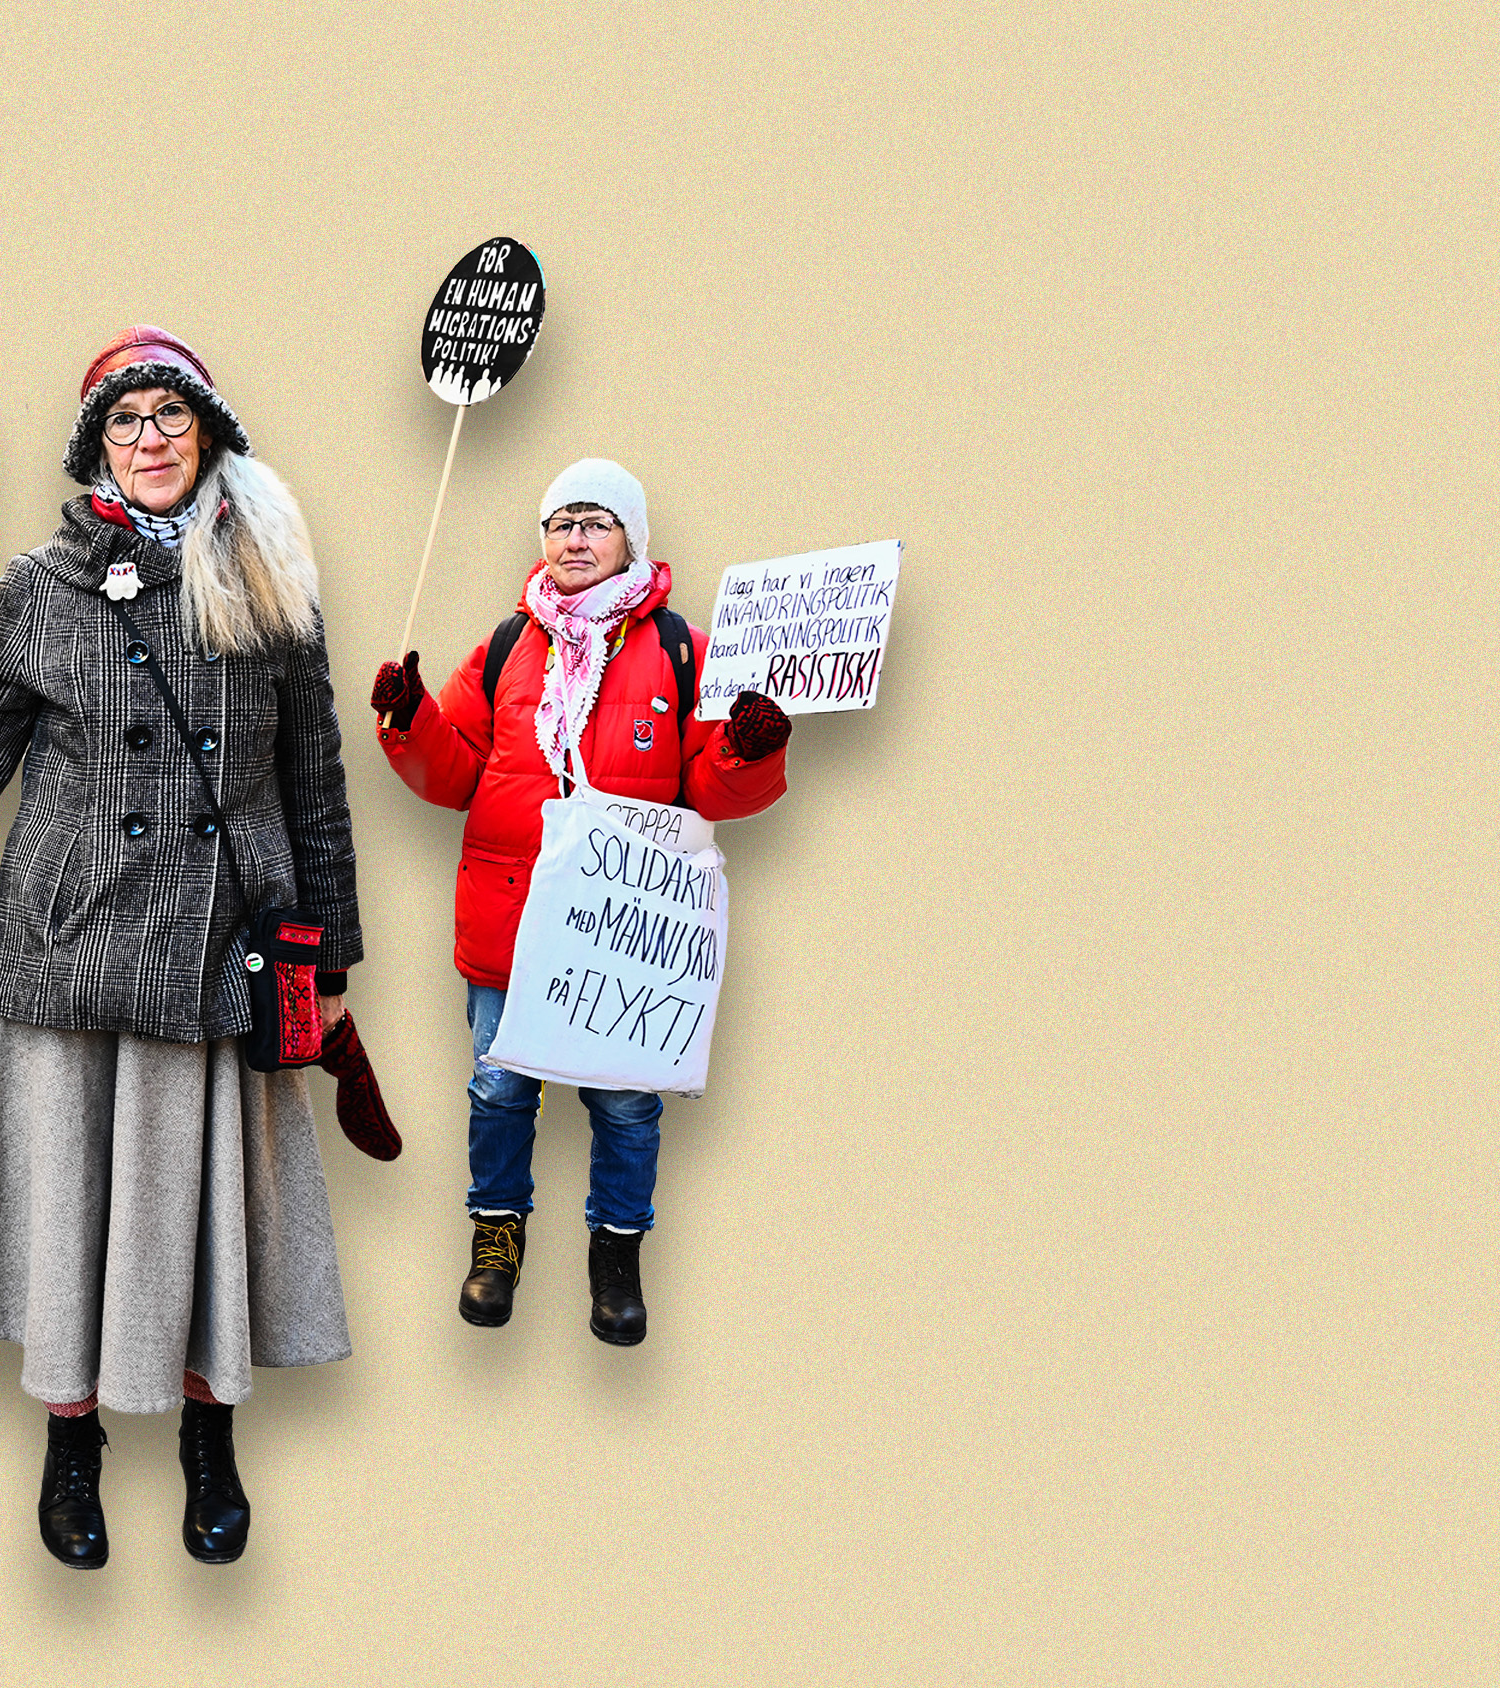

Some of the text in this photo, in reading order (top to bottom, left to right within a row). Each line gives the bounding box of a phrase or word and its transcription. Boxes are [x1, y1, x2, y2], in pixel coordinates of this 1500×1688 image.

[476, 240, 512, 273] FÖR
[444, 278, 538, 312] EN HUMAN
[431, 336, 500, 366] POLITIK!
[724, 562, 876, 600] Idag har vi ingen
[717, 579, 894, 628] INVANDRINGSPOLITIK
[710, 613, 887, 659] bara UTVISNINGSPOLITIK
[700, 677, 722, 699] och
[764, 647, 881, 707] RASISTISK!
[566, 906, 596, 934] MED
[546, 968, 706, 1066] PÅ FLYKT!
